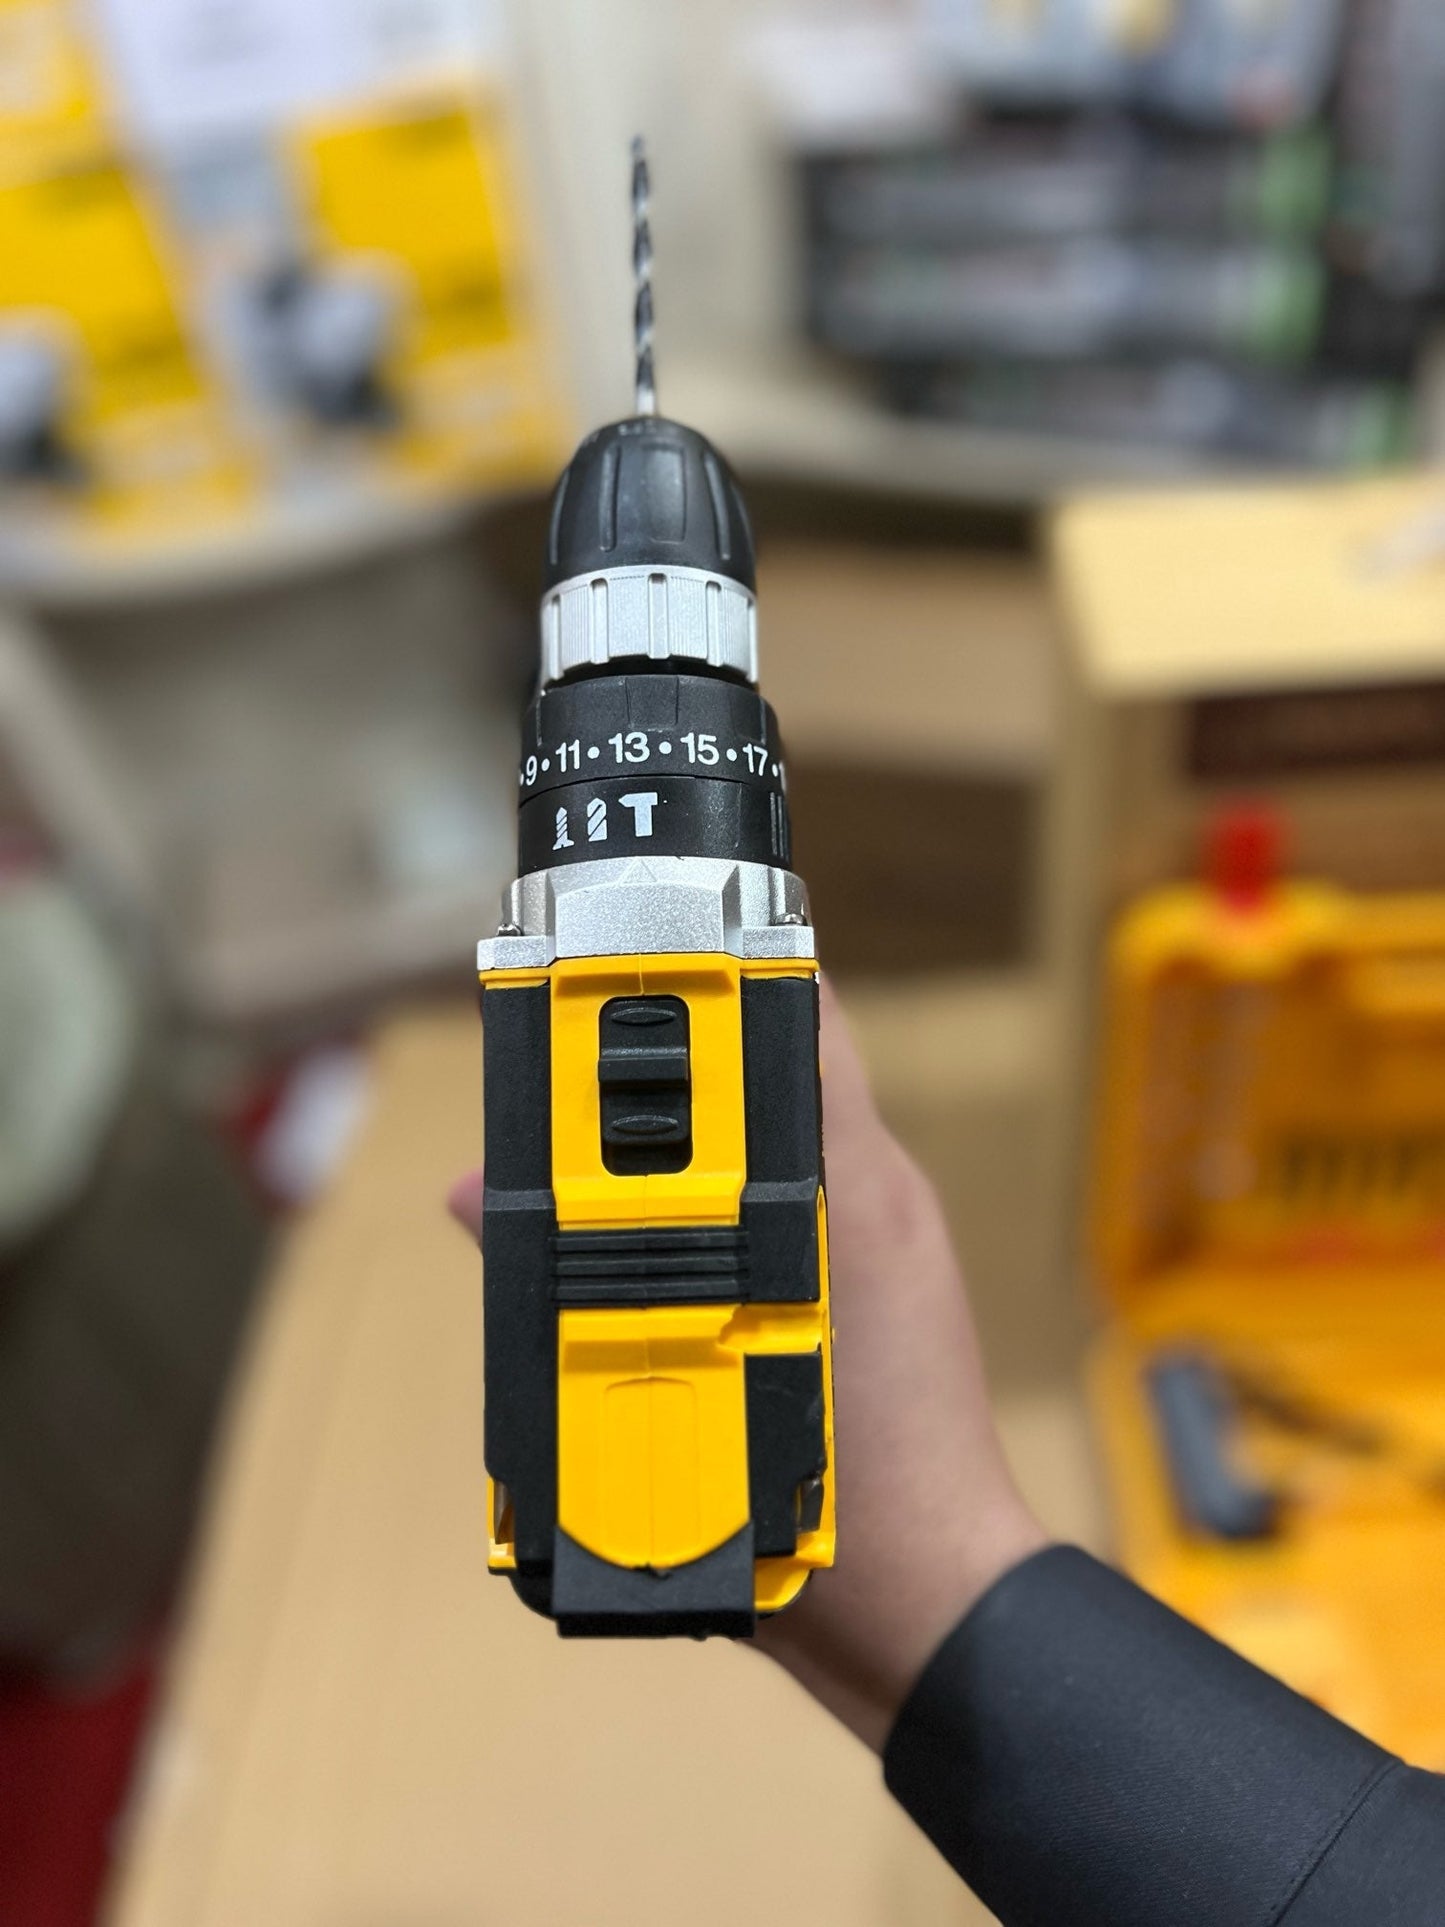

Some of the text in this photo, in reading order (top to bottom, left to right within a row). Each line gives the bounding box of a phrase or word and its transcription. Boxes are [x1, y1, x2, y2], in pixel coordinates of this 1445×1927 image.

[526, 732, 769, 785] 9 11 13 15 17
